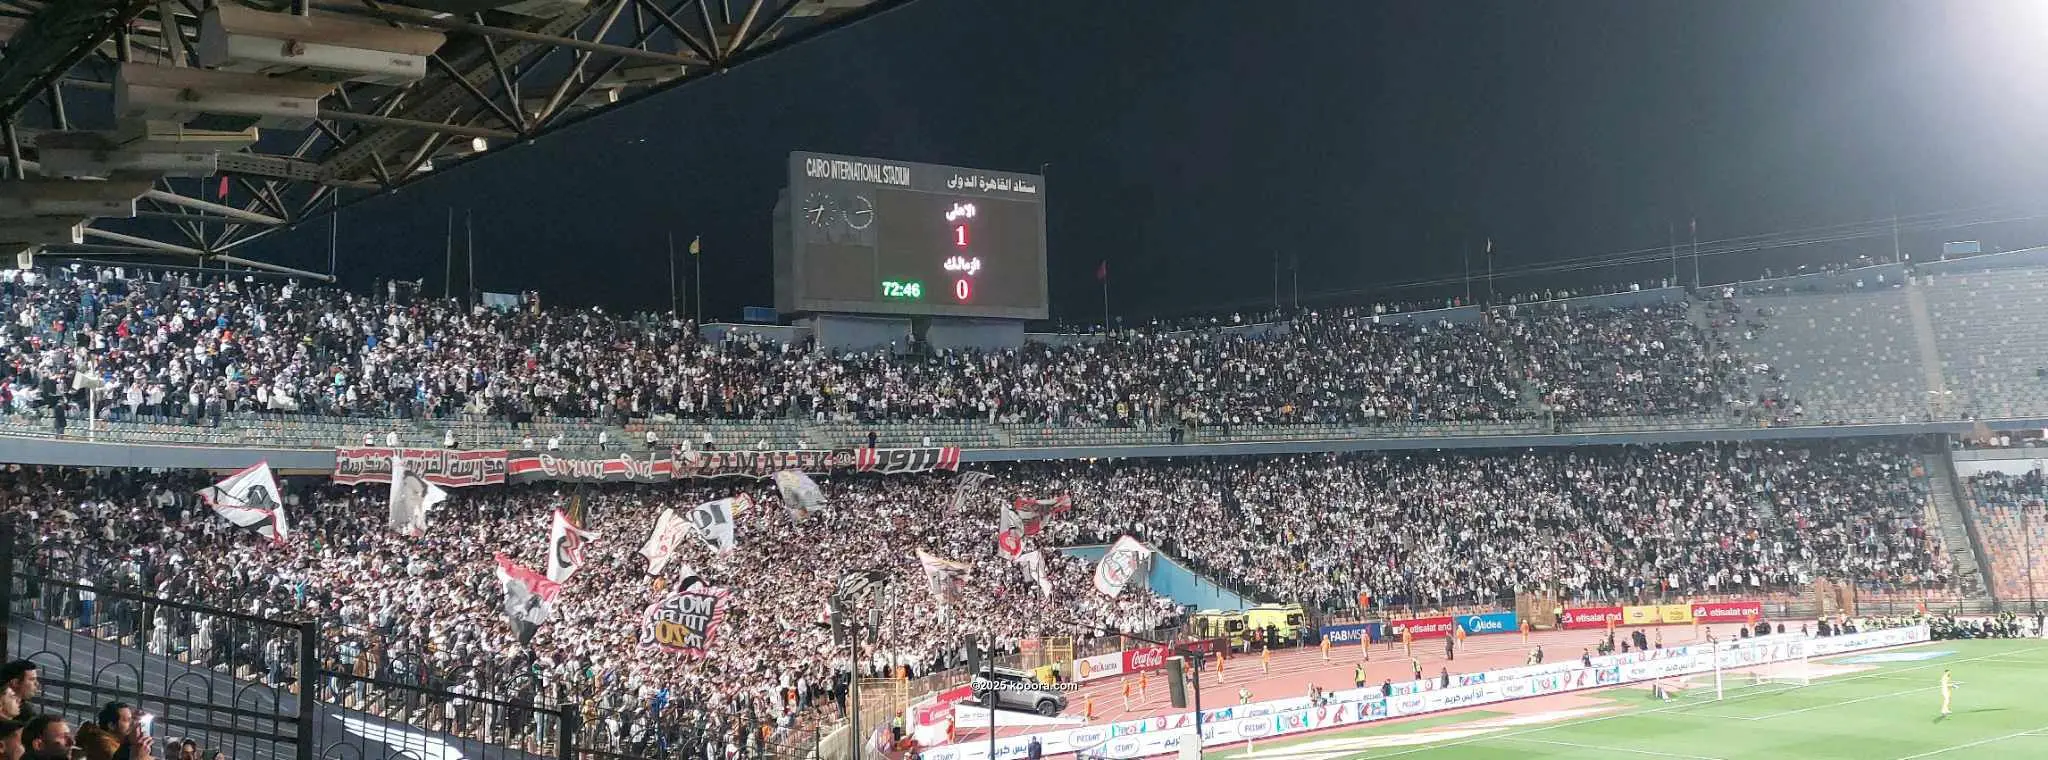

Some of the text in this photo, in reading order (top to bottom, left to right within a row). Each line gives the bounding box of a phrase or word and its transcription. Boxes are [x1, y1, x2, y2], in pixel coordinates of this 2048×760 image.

[805, 158, 910, 186] CAIRO INTERNATIONAL STADIUM
[979, 175, 1011, 192] القاهرة
[1013, 179, 1036, 193] ستاد
[955, 225, 967, 246] 1
[882, 281, 921, 298] 72:46
[955, 279, 969, 300] 0
[699, 450, 833, 475] ZAMALEK
[873, 450, 937, 473] 1911
